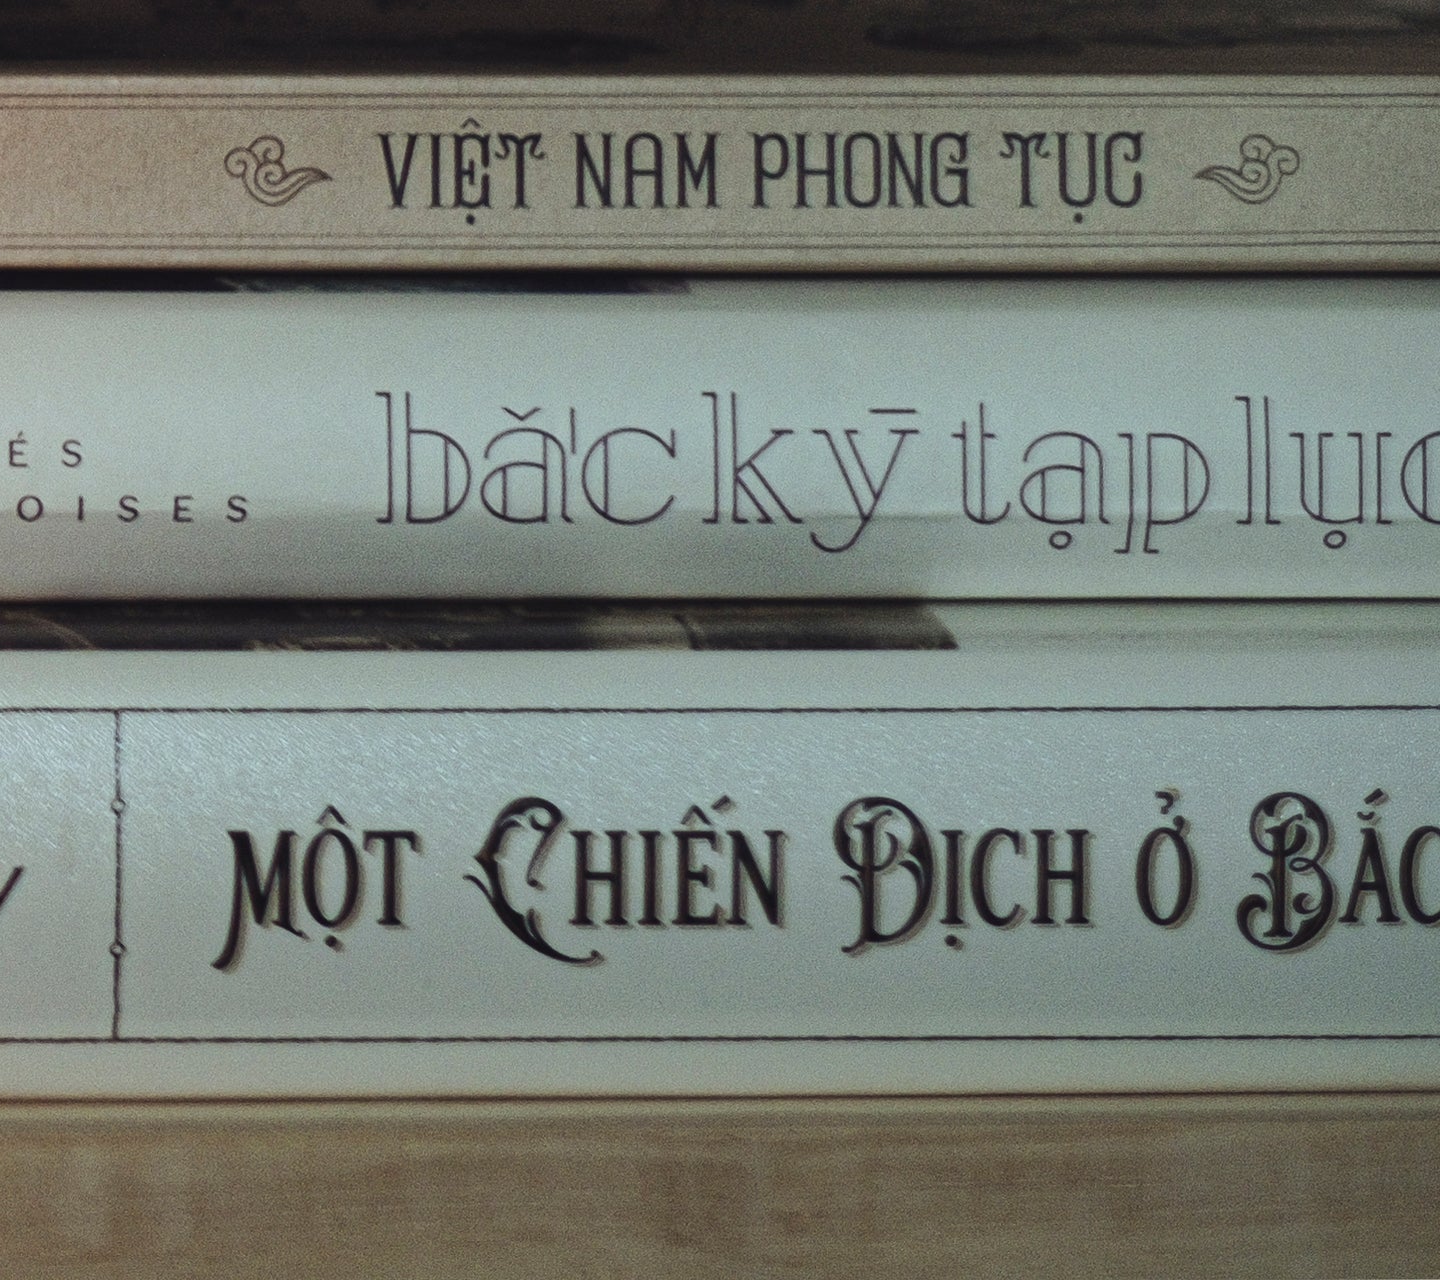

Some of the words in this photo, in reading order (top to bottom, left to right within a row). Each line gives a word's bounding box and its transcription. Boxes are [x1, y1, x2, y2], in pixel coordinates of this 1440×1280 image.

[376, 117, 546, 225] VIỆT
[573, 132, 721, 209] NAM
[750, 132, 975, 209] PHONG
[999, 131, 1145, 225] TỤC
[952, 402, 1211, 554] tạp
[212, 806, 423, 970] MỘT
[464, 794, 787, 966] CHIẾN
[1134, 787, 1200, 928] Ở
